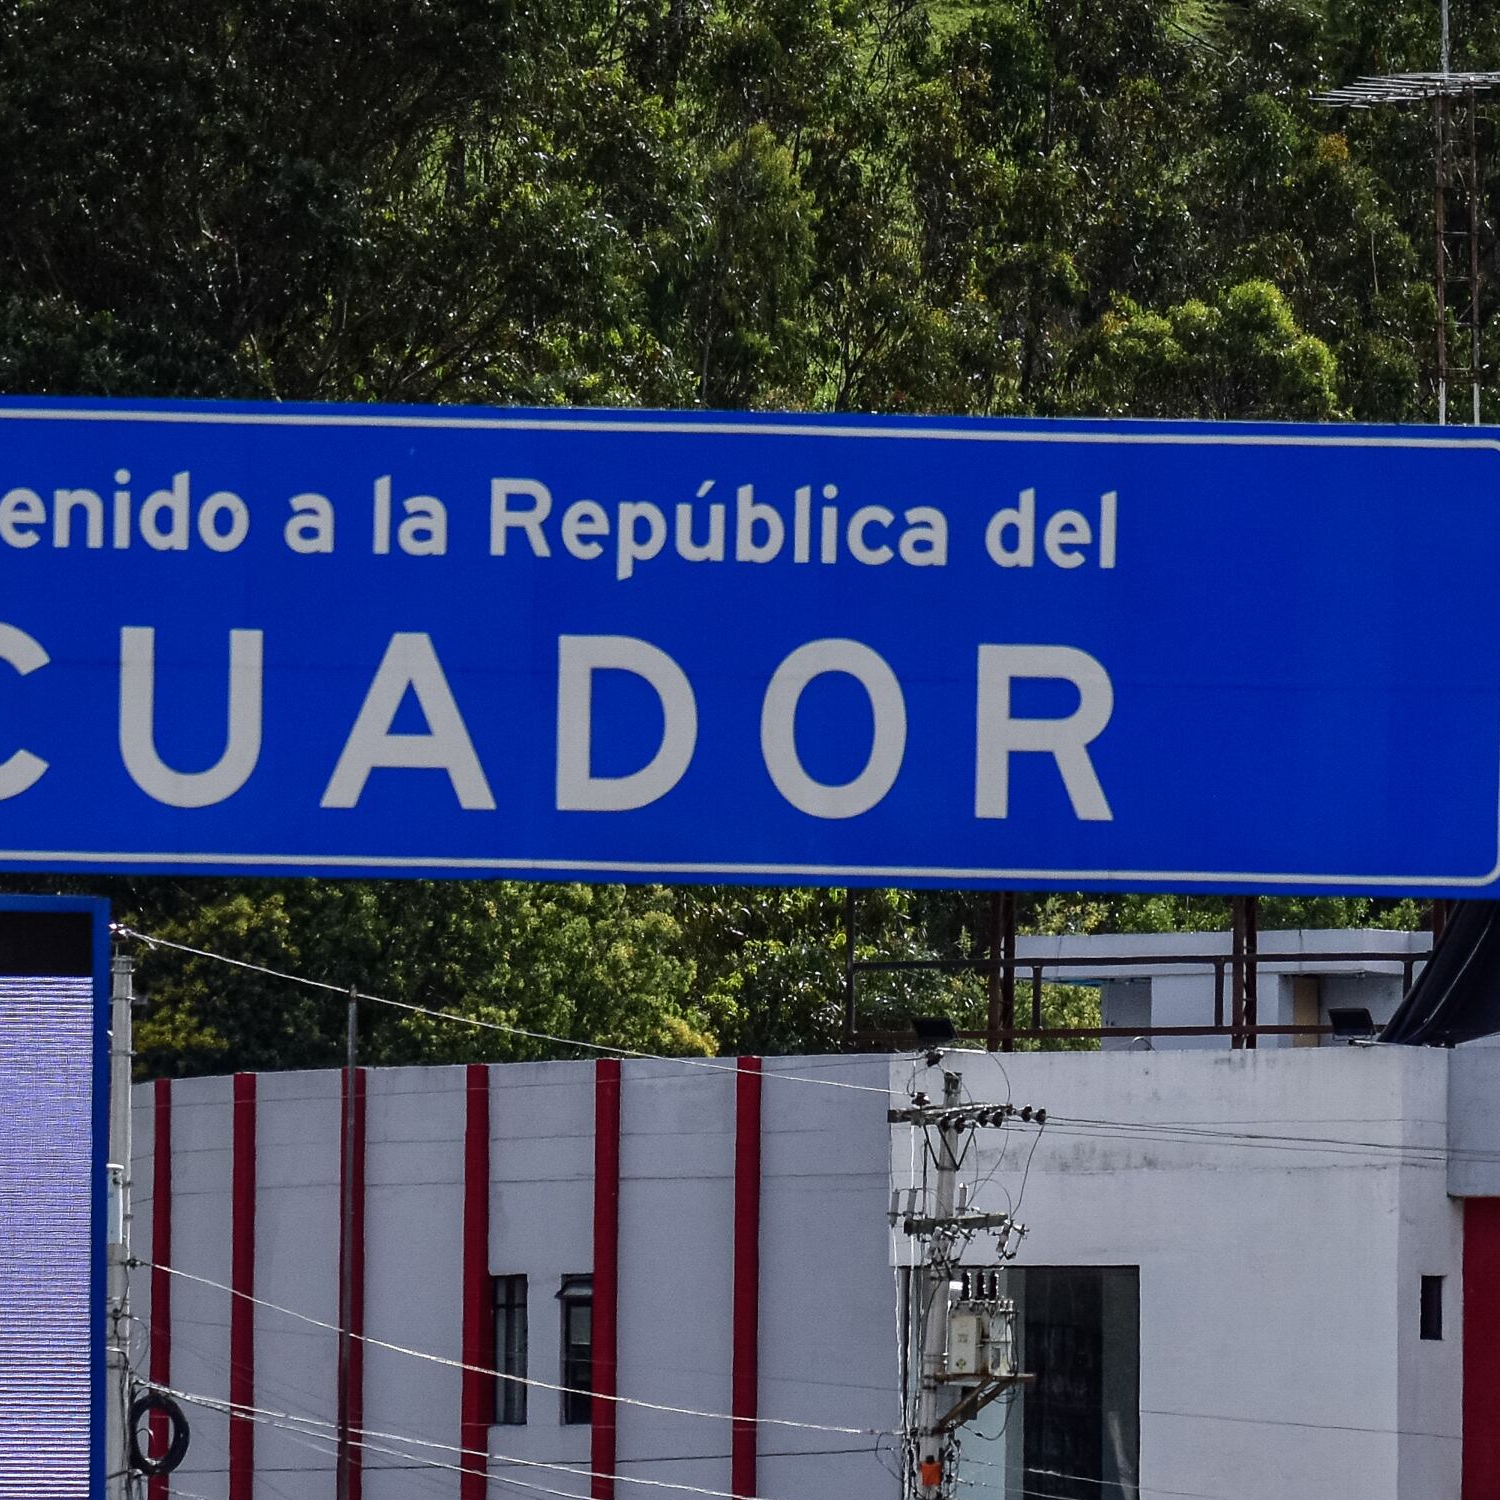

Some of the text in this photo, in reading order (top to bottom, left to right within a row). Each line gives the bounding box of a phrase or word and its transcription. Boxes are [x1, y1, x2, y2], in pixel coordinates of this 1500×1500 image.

[283, 490, 335, 556] a
[372, 474, 449, 560] la
[488, 474, 949, 582] República
[984, 484, 1119, 573] del
